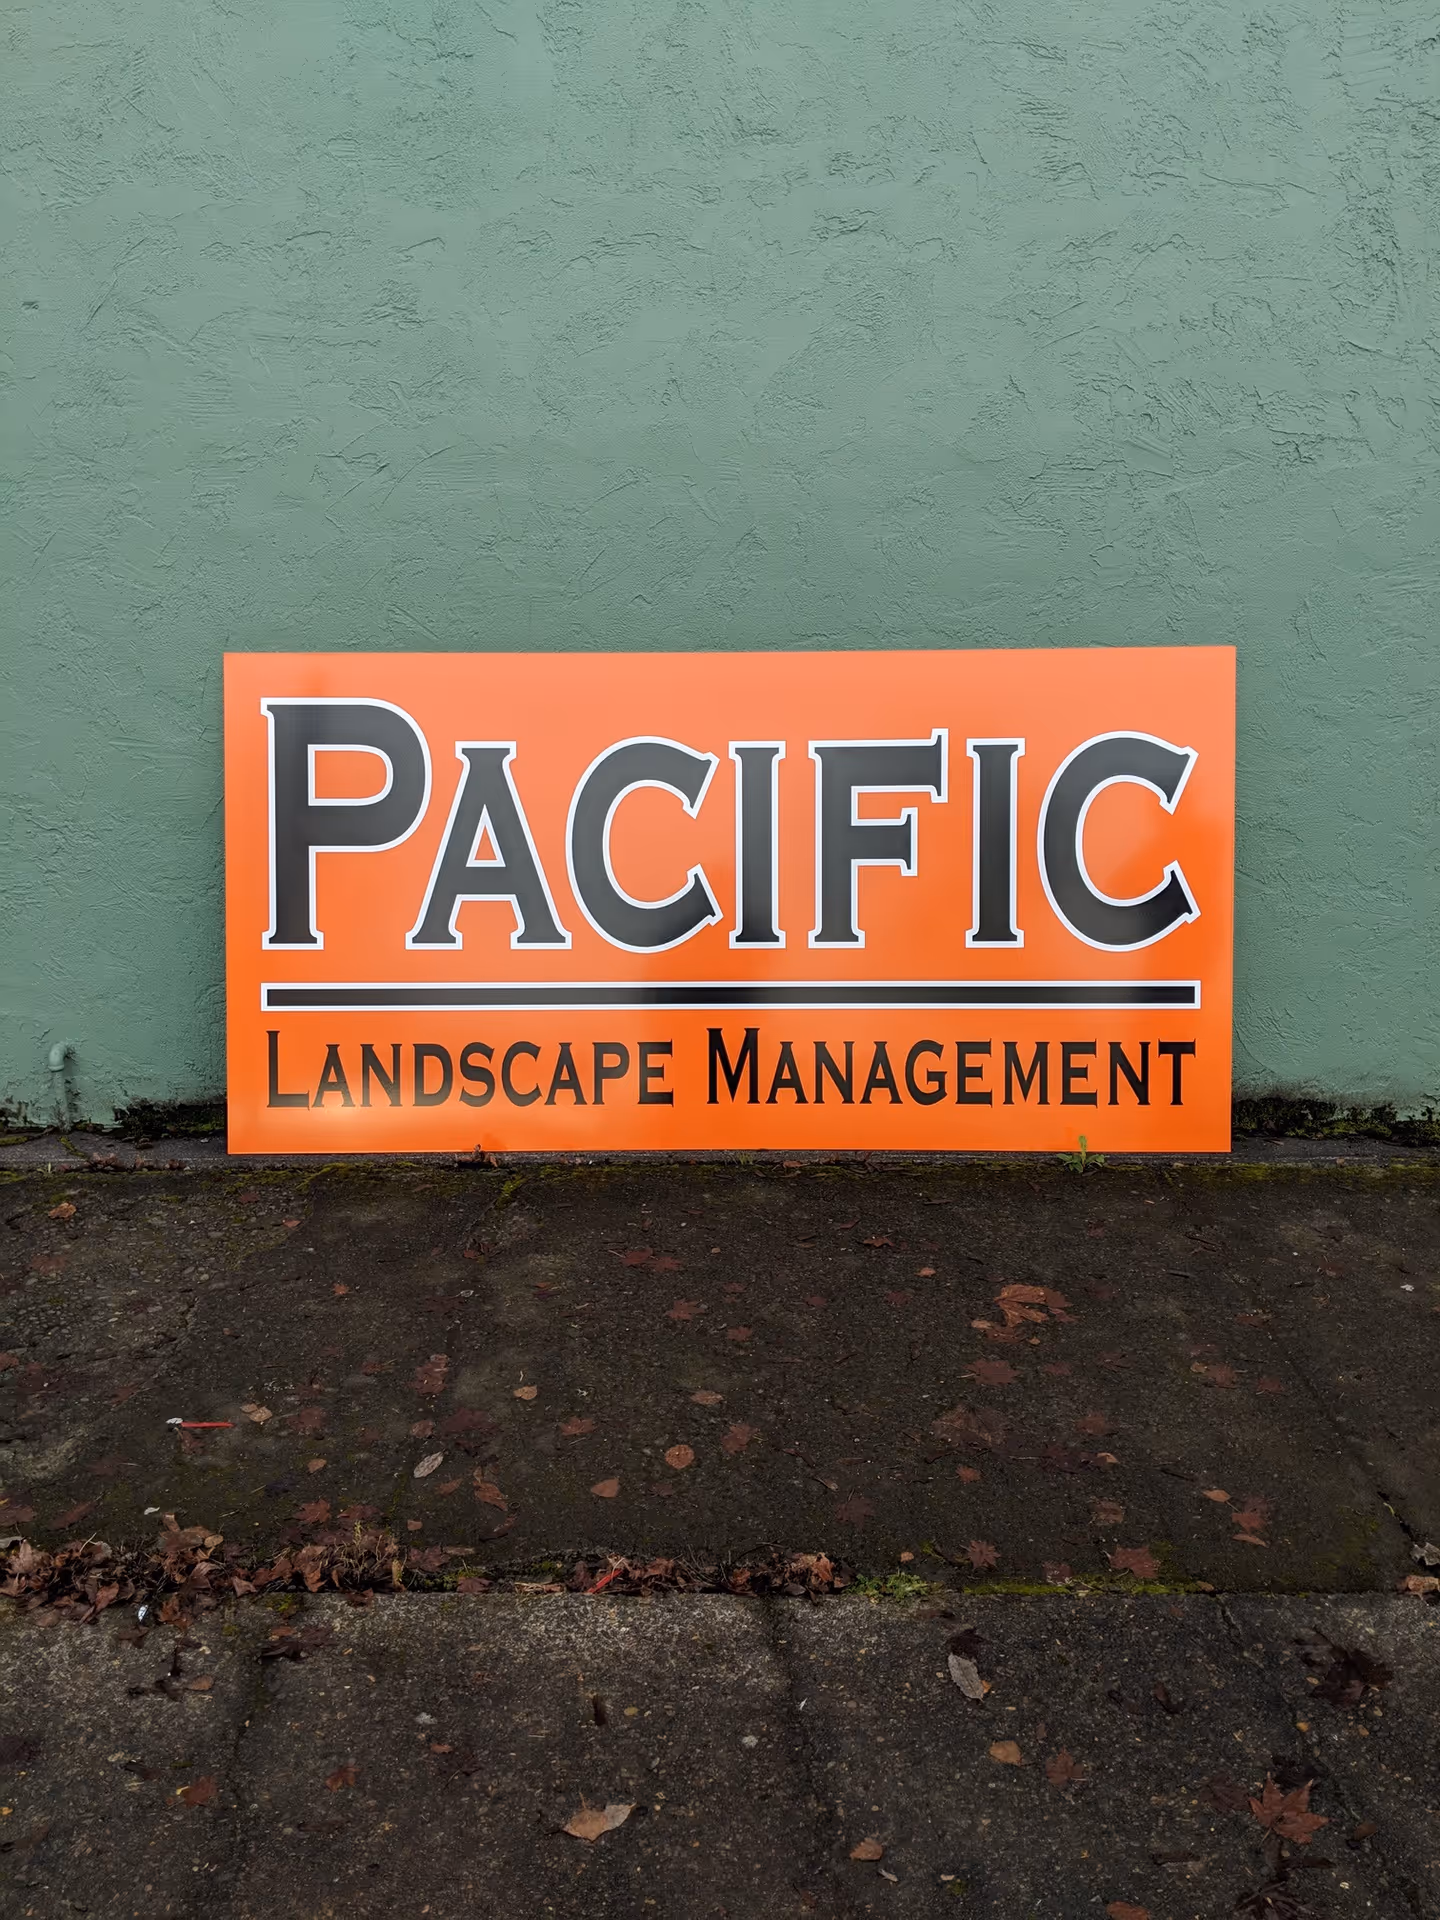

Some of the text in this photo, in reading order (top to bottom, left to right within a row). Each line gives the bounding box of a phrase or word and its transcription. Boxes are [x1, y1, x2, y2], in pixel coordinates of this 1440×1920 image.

[260, 696, 1200, 953] PACIFIC
[266, 1027, 1196, 1108] LANDSCAPE MANAGEMENT
